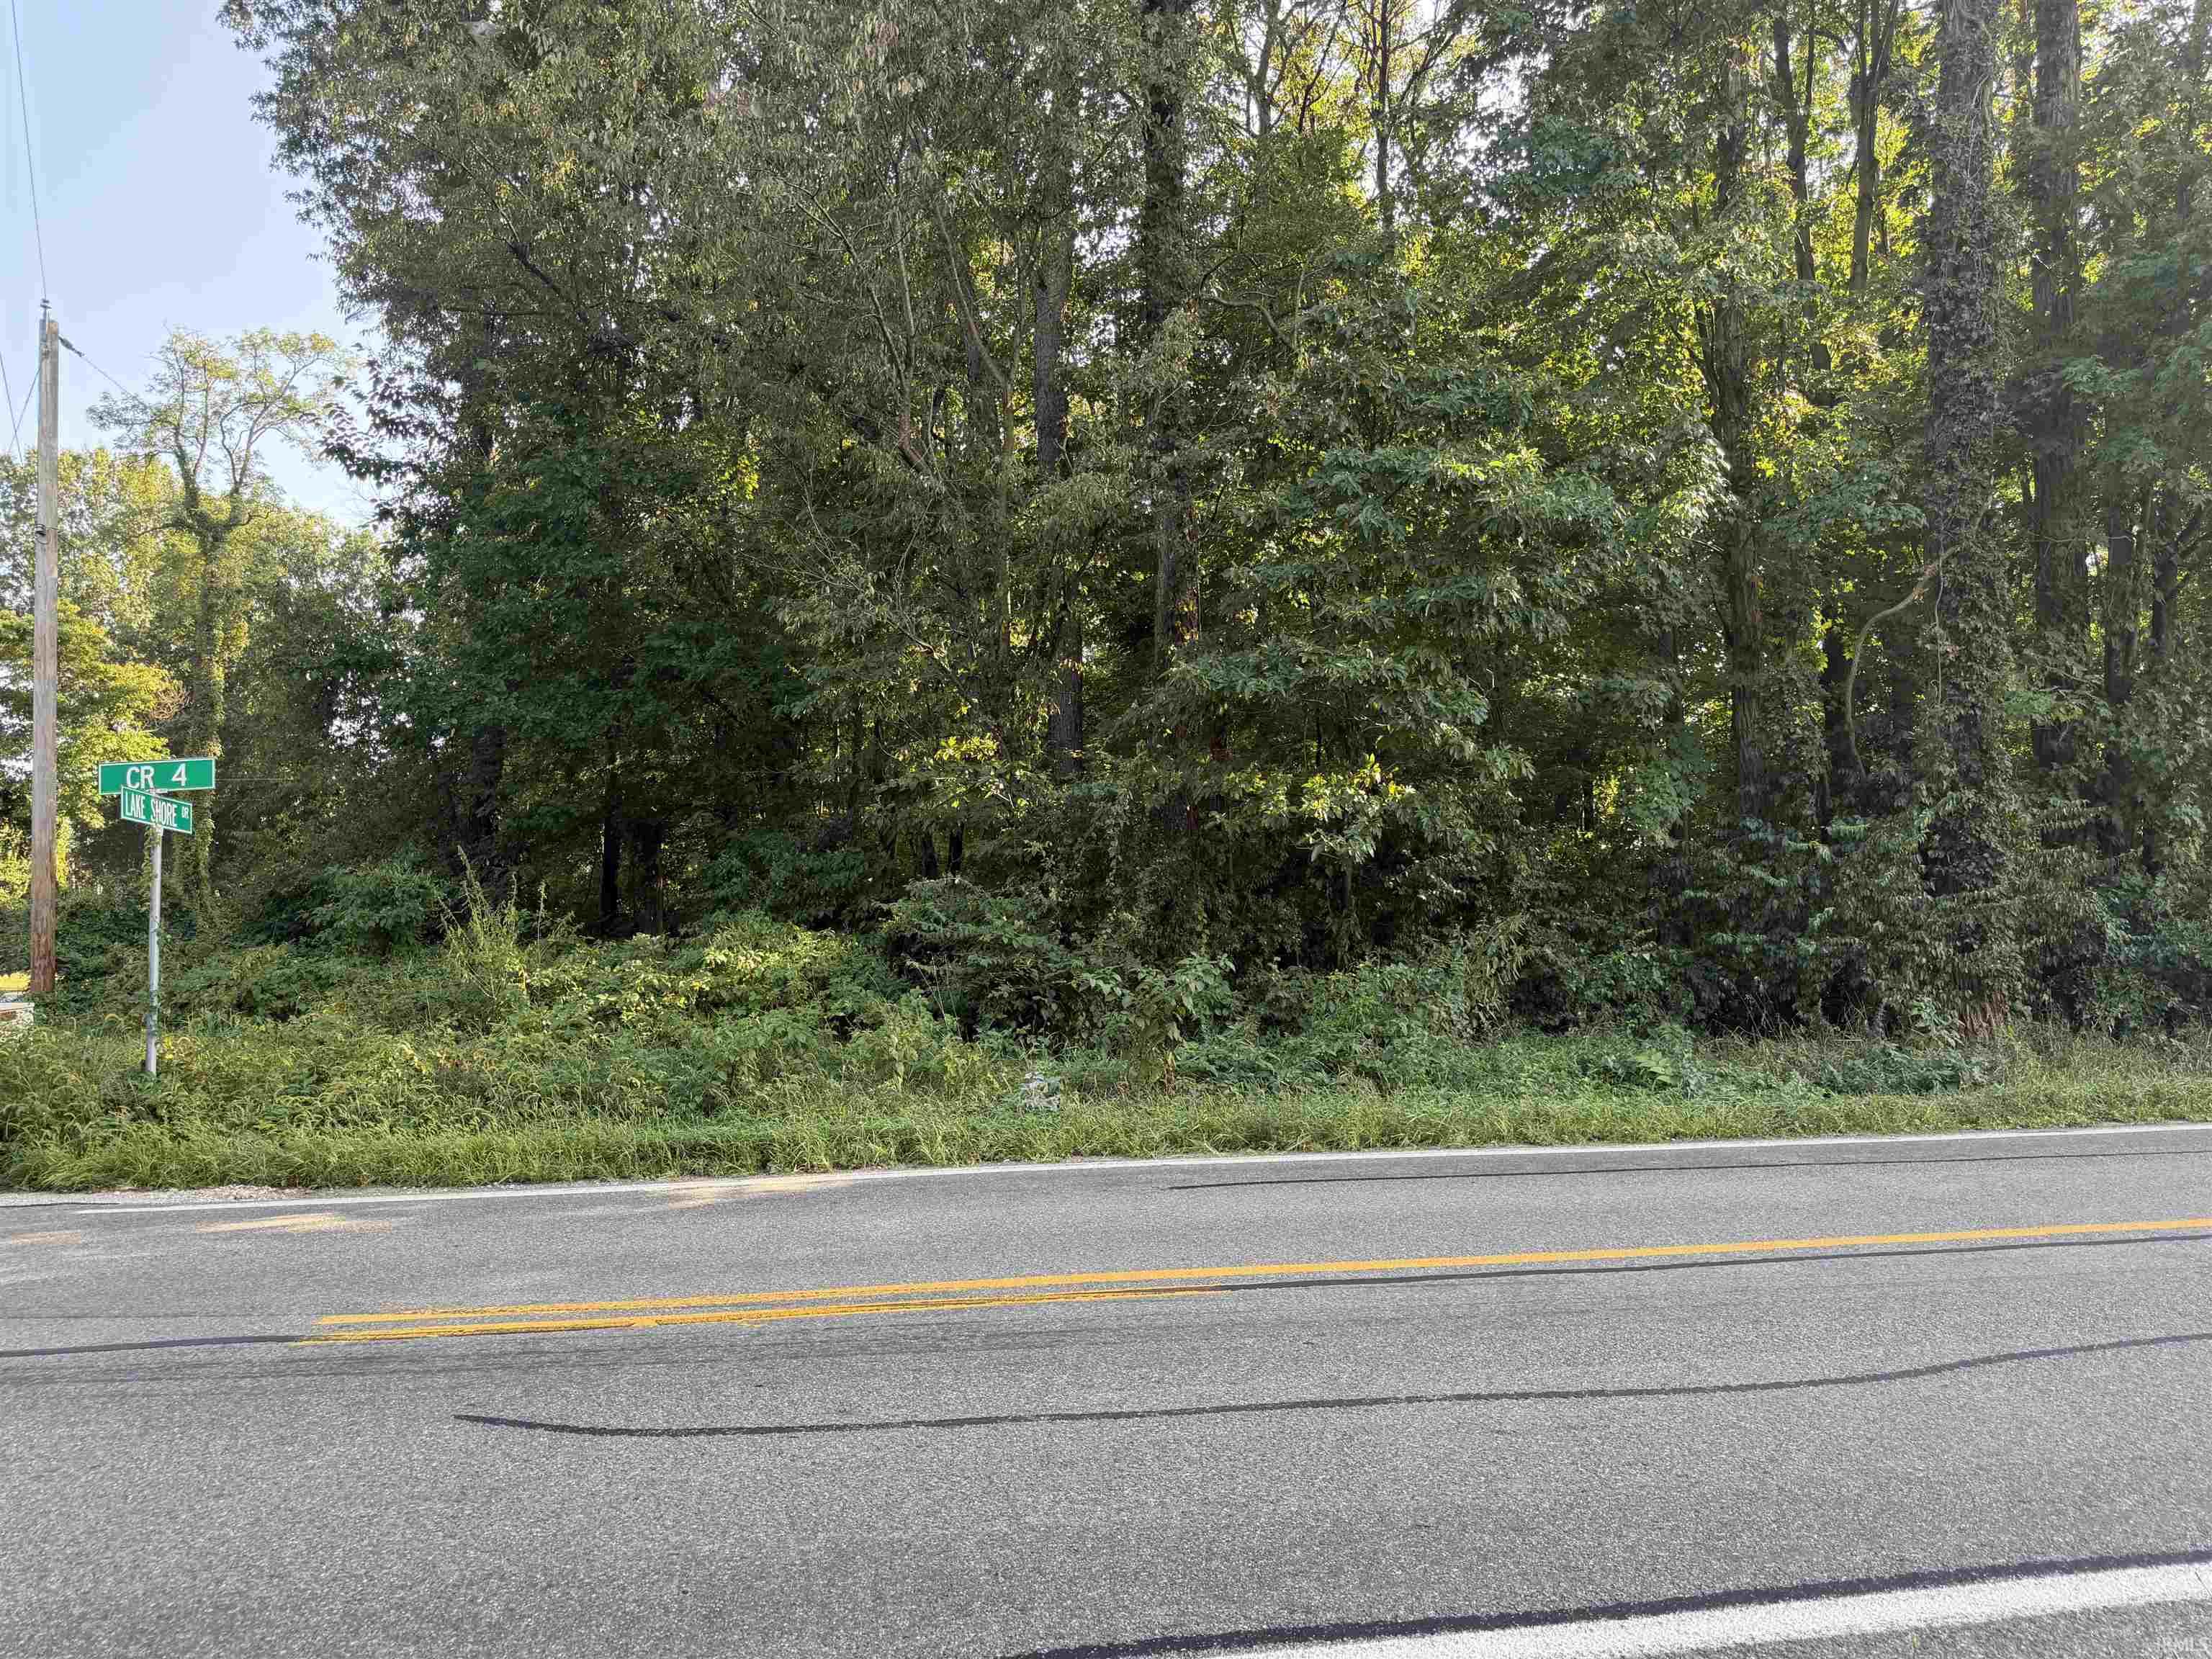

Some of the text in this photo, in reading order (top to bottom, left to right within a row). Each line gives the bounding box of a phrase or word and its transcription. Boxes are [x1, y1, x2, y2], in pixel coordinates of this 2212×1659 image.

[127, 763, 187, 789] CR 4
[125, 792, 189, 827] LAKE SHORE DR
